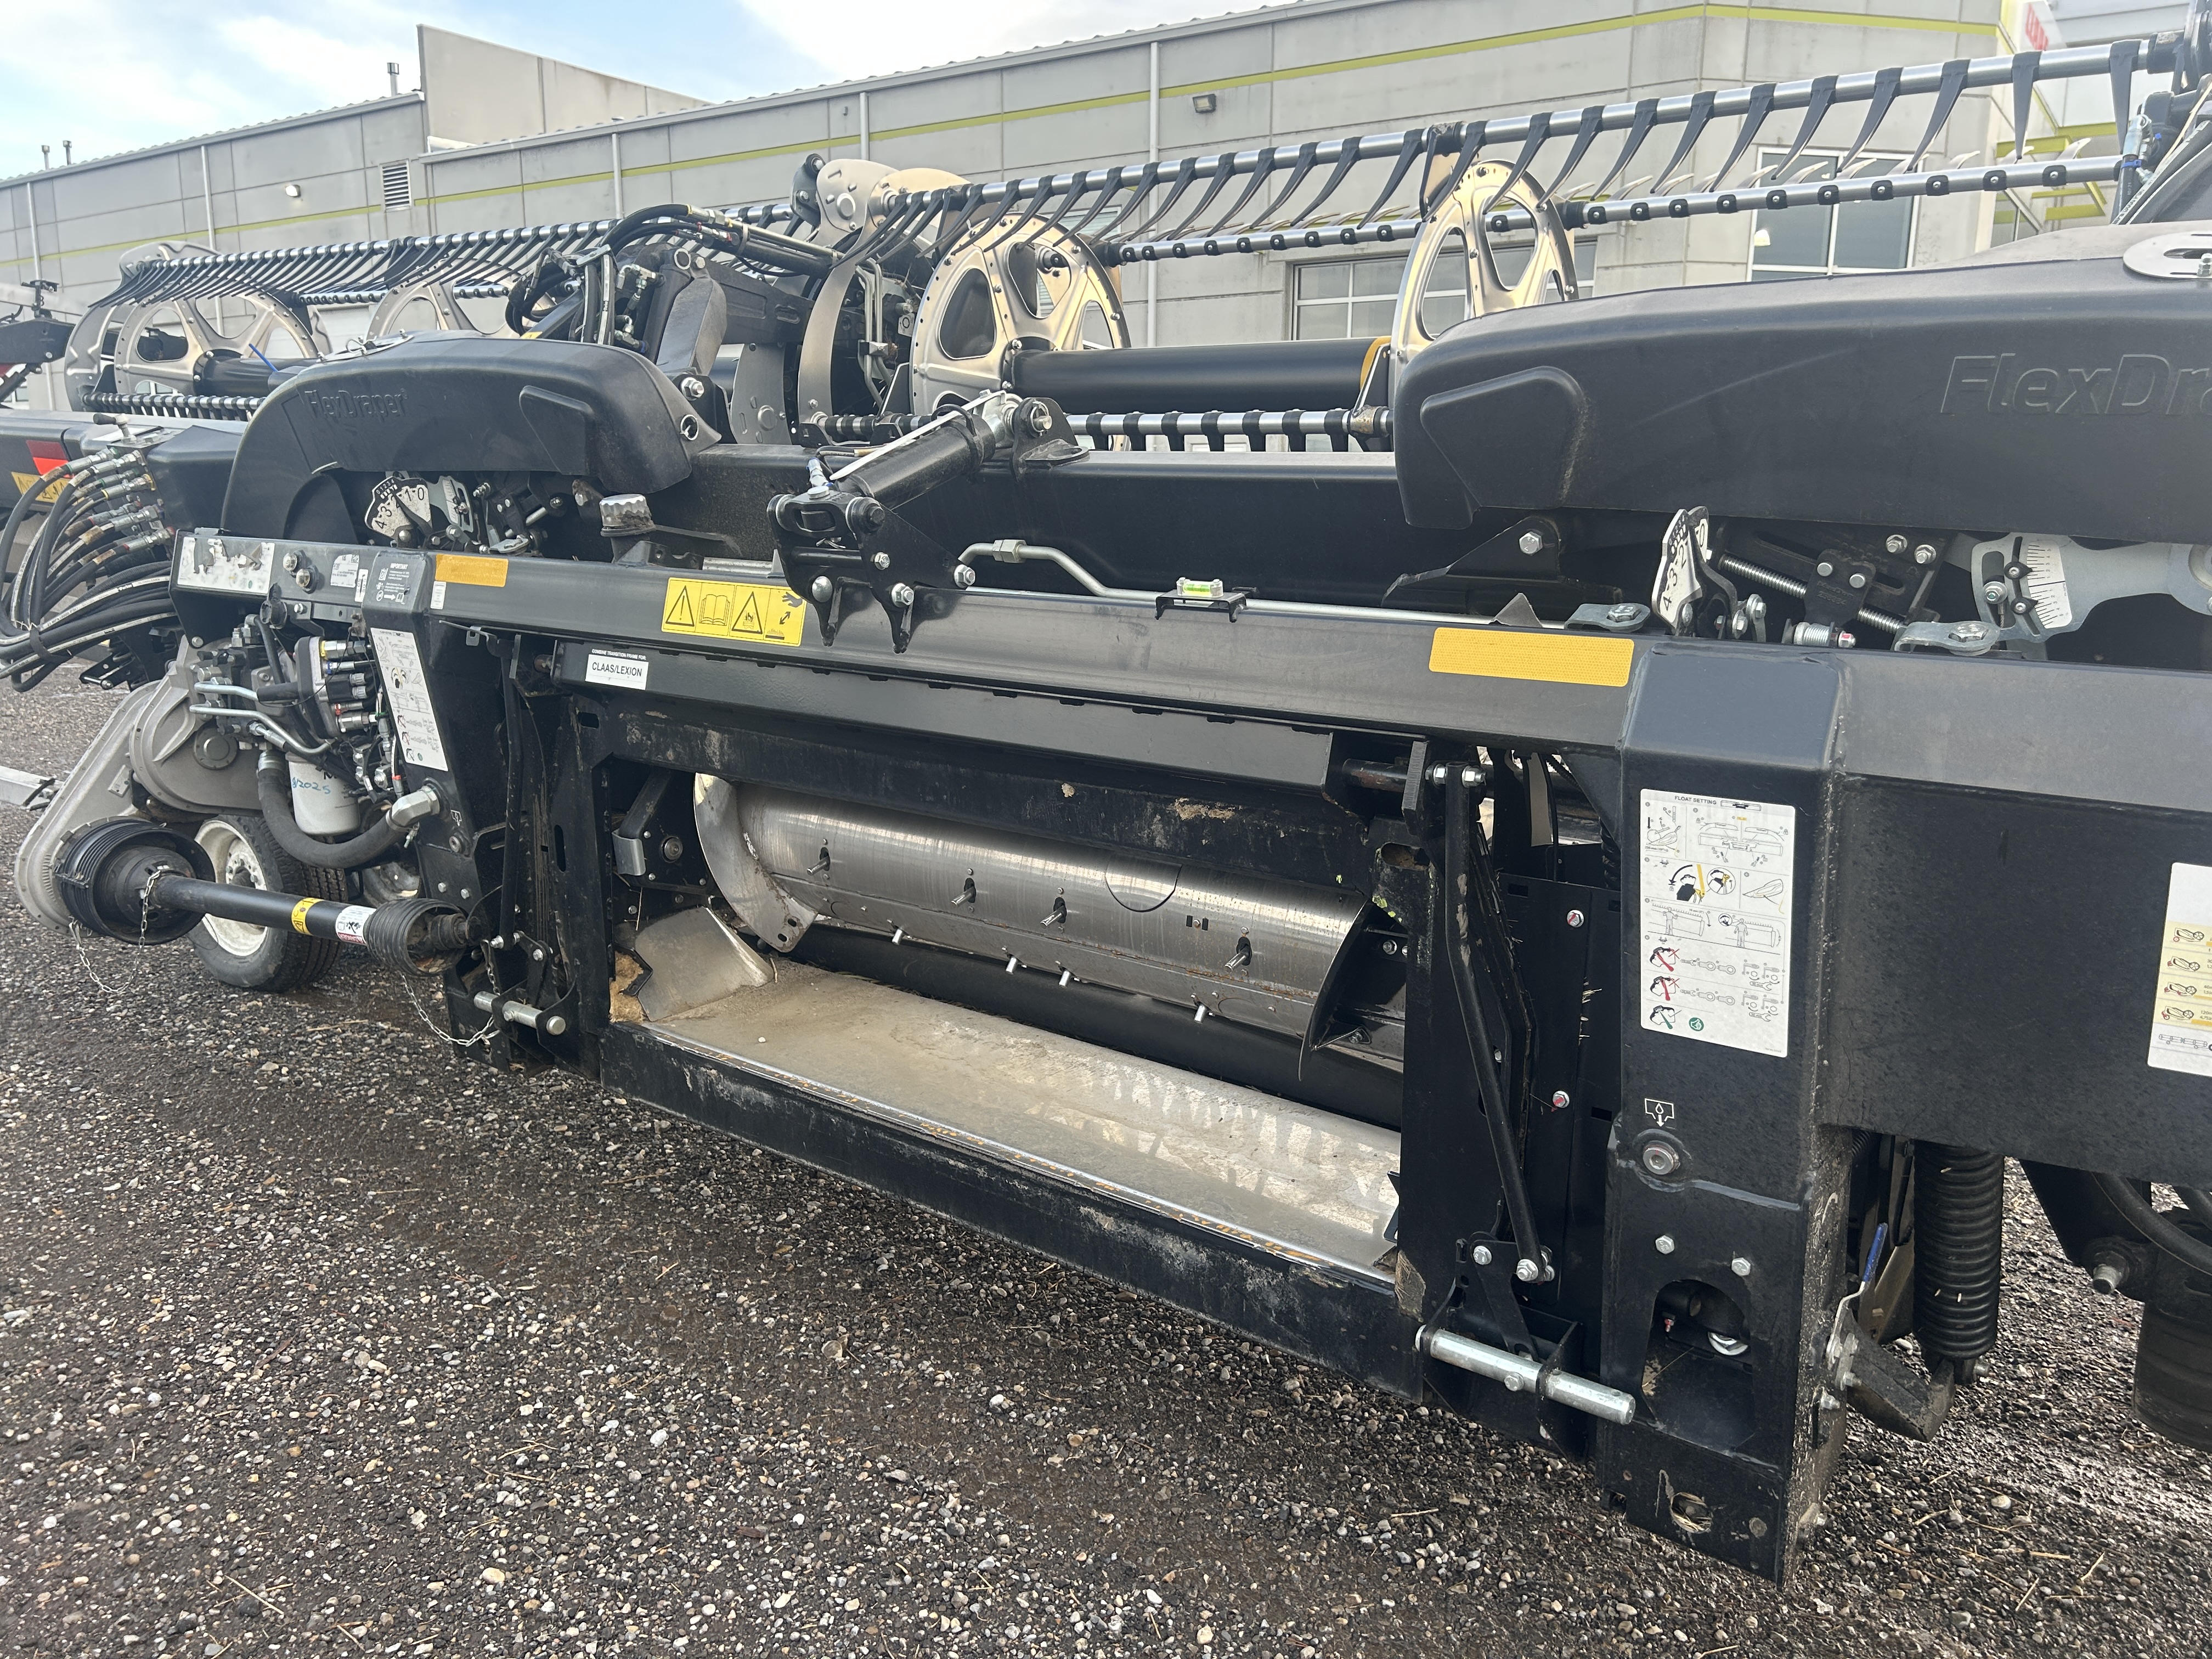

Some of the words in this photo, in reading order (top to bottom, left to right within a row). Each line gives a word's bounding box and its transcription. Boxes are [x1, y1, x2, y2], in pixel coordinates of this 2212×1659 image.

[1940, 353, 2212, 415] FlexDr
[375, 520, 387, 529] 4
[381, 506, 392, 517] 3
[405, 488, 412, 502] 1
[417, 487, 425, 500] 0
[1663, 596, 1672, 611] 4
[1669, 567, 1678, 587] 3
[1678, 544, 1686, 569] 2
[1699, 523, 1706, 548] 0
[592, 662, 642, 676] CLAAS/LEXION
